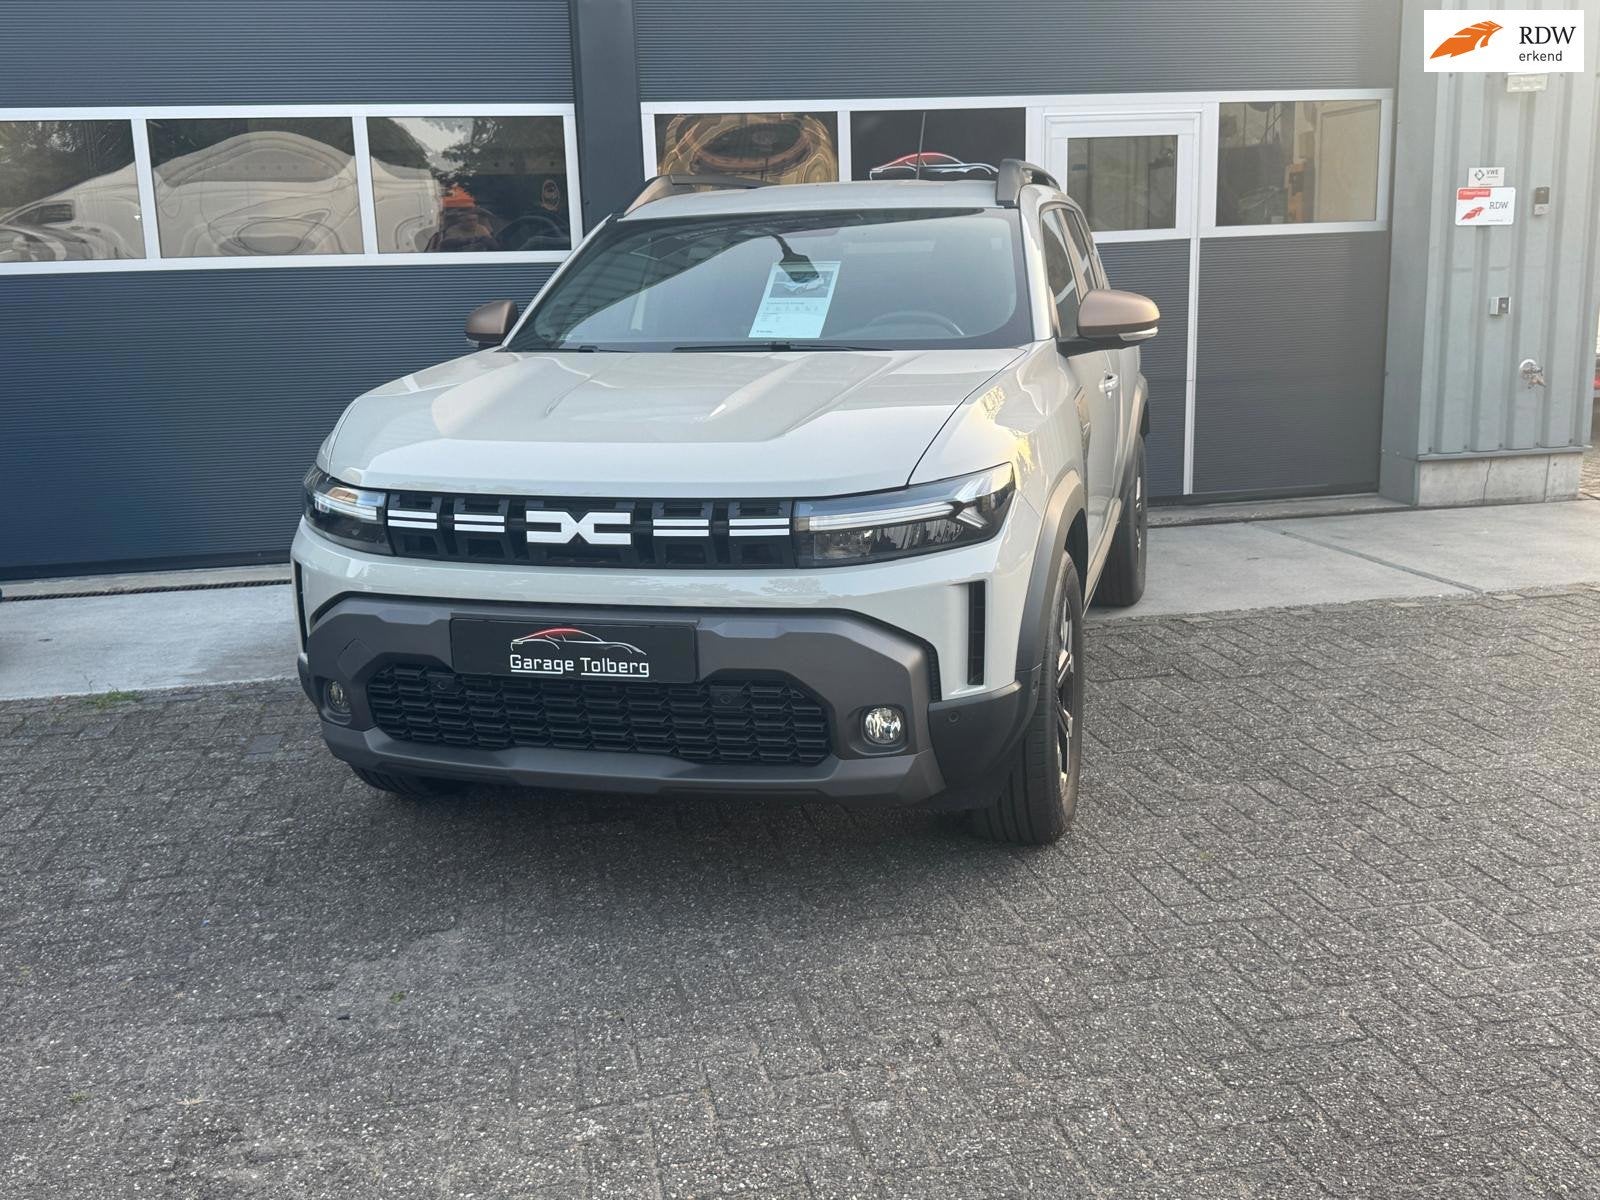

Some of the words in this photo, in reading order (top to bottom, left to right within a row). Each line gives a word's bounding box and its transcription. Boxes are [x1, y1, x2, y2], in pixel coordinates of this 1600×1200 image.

[1489, 201, 1509, 210] RDW
[509, 654, 575, 675] Garage
[580, 657, 650, 678] Tolberg
